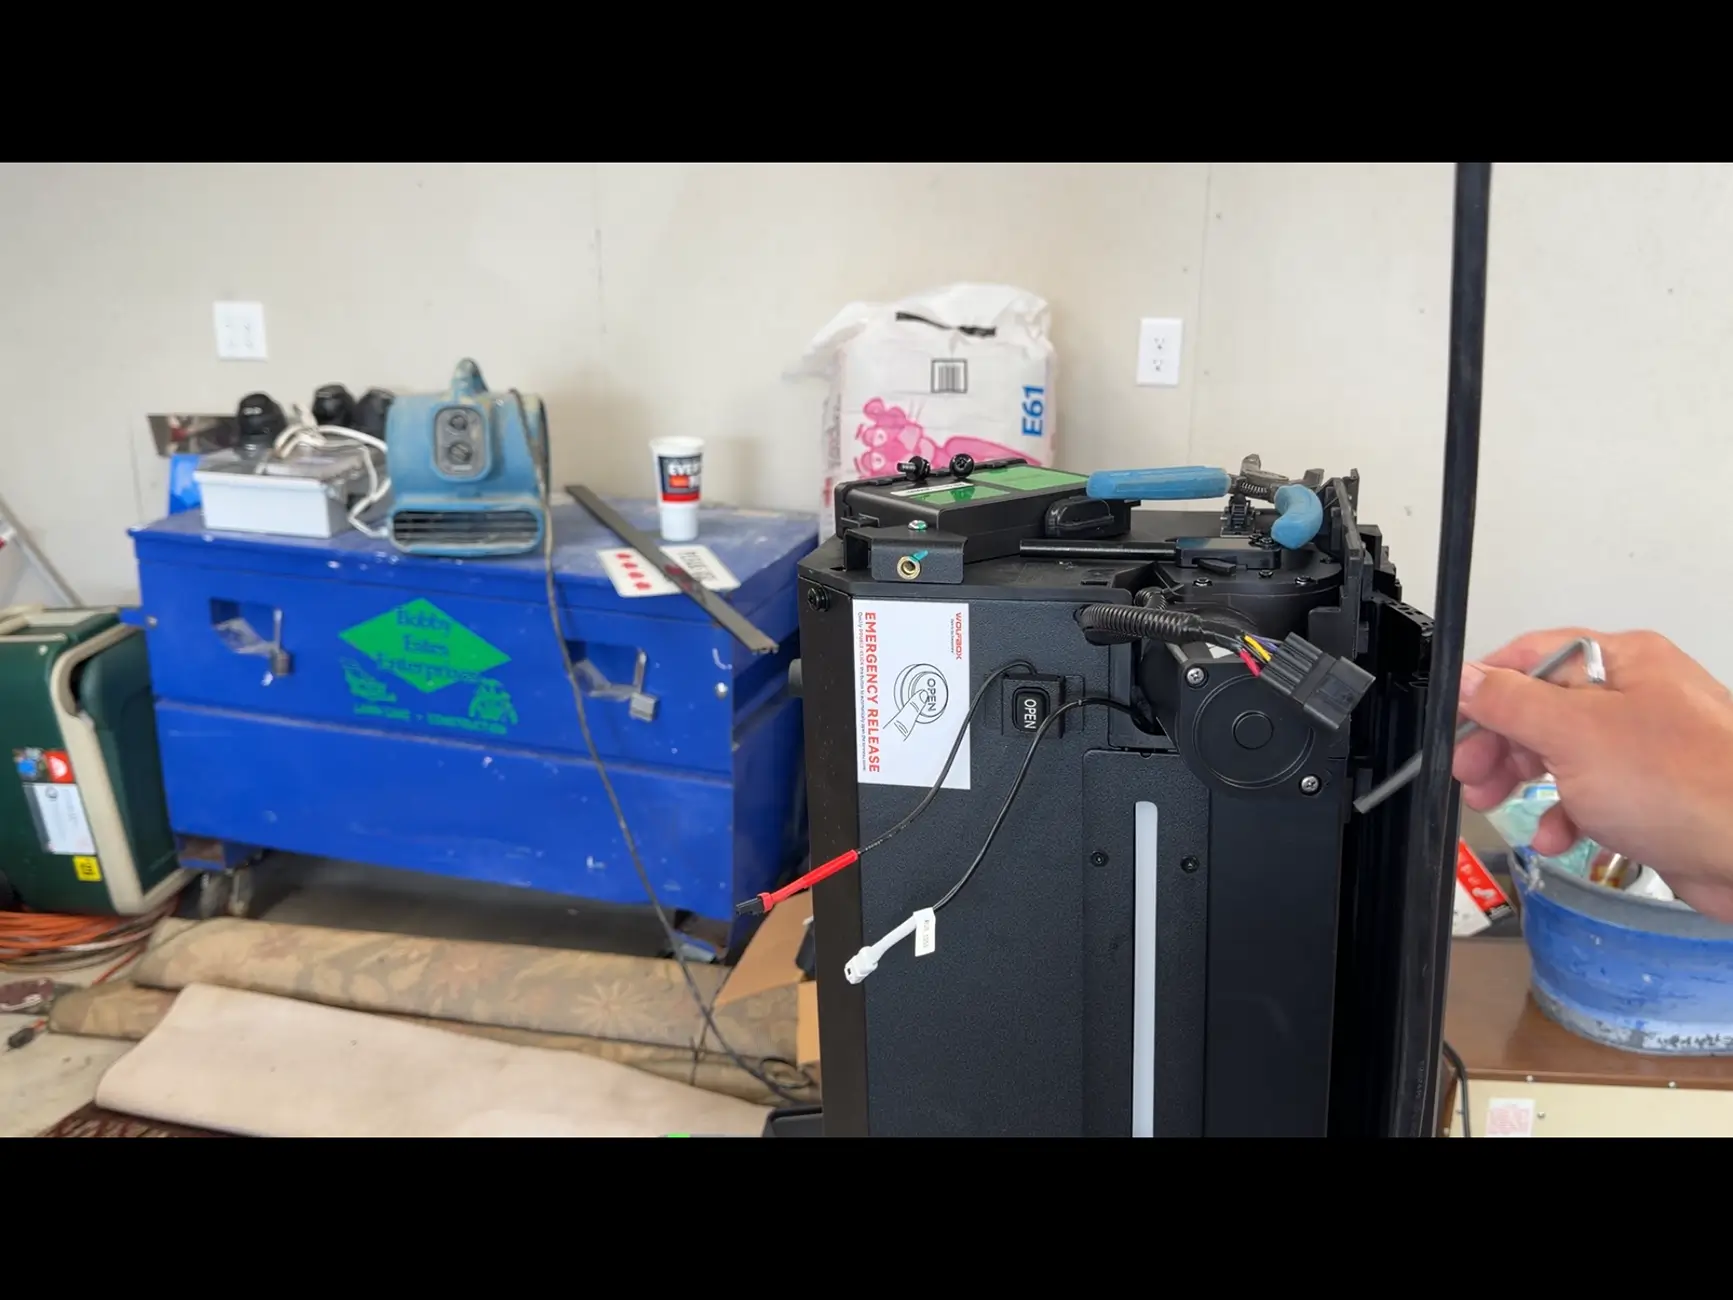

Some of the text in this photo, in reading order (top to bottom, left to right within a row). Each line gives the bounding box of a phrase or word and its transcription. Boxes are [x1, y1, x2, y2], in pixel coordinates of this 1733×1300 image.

[1022, 384, 1044, 437] E61
[955, 612, 963, 660] WOLFBOX
[865, 612, 880, 773] EMERGENCY RELEASE
[926, 677, 936, 712] OPEN
[1024, 698, 1037, 729] OPEN
